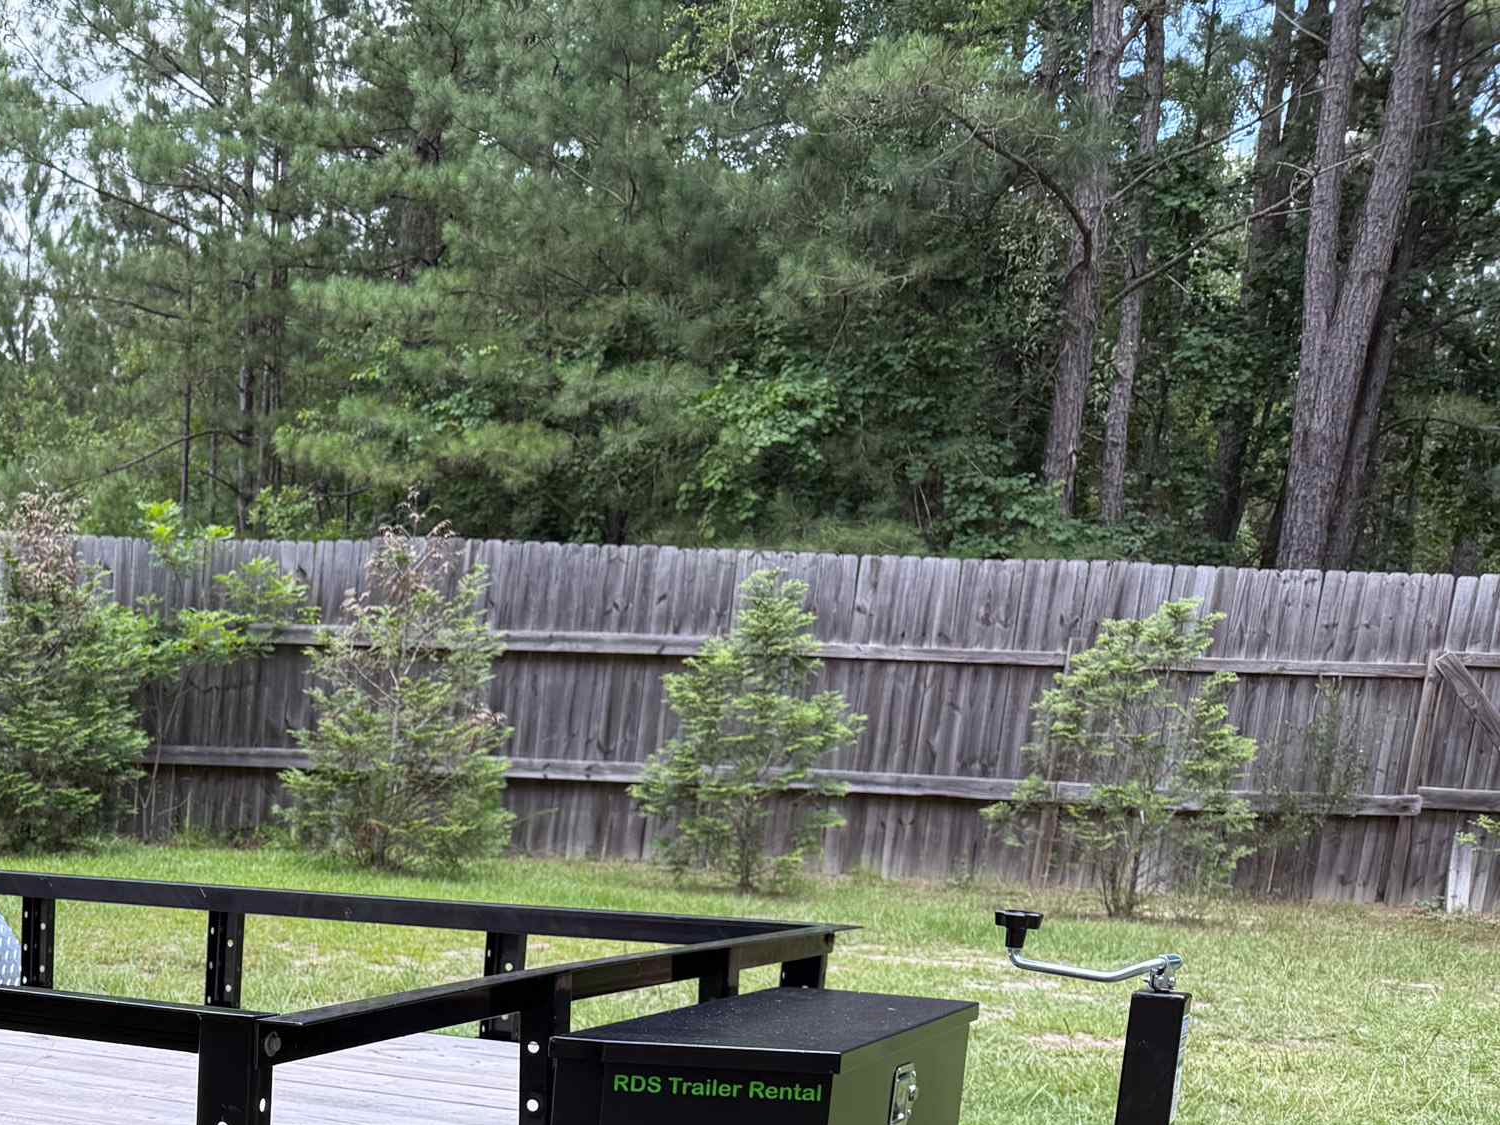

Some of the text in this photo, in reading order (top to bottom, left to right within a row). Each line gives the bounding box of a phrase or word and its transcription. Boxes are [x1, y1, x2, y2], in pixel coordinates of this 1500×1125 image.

[613, 1074, 823, 1102] RDS Trailer Rental
